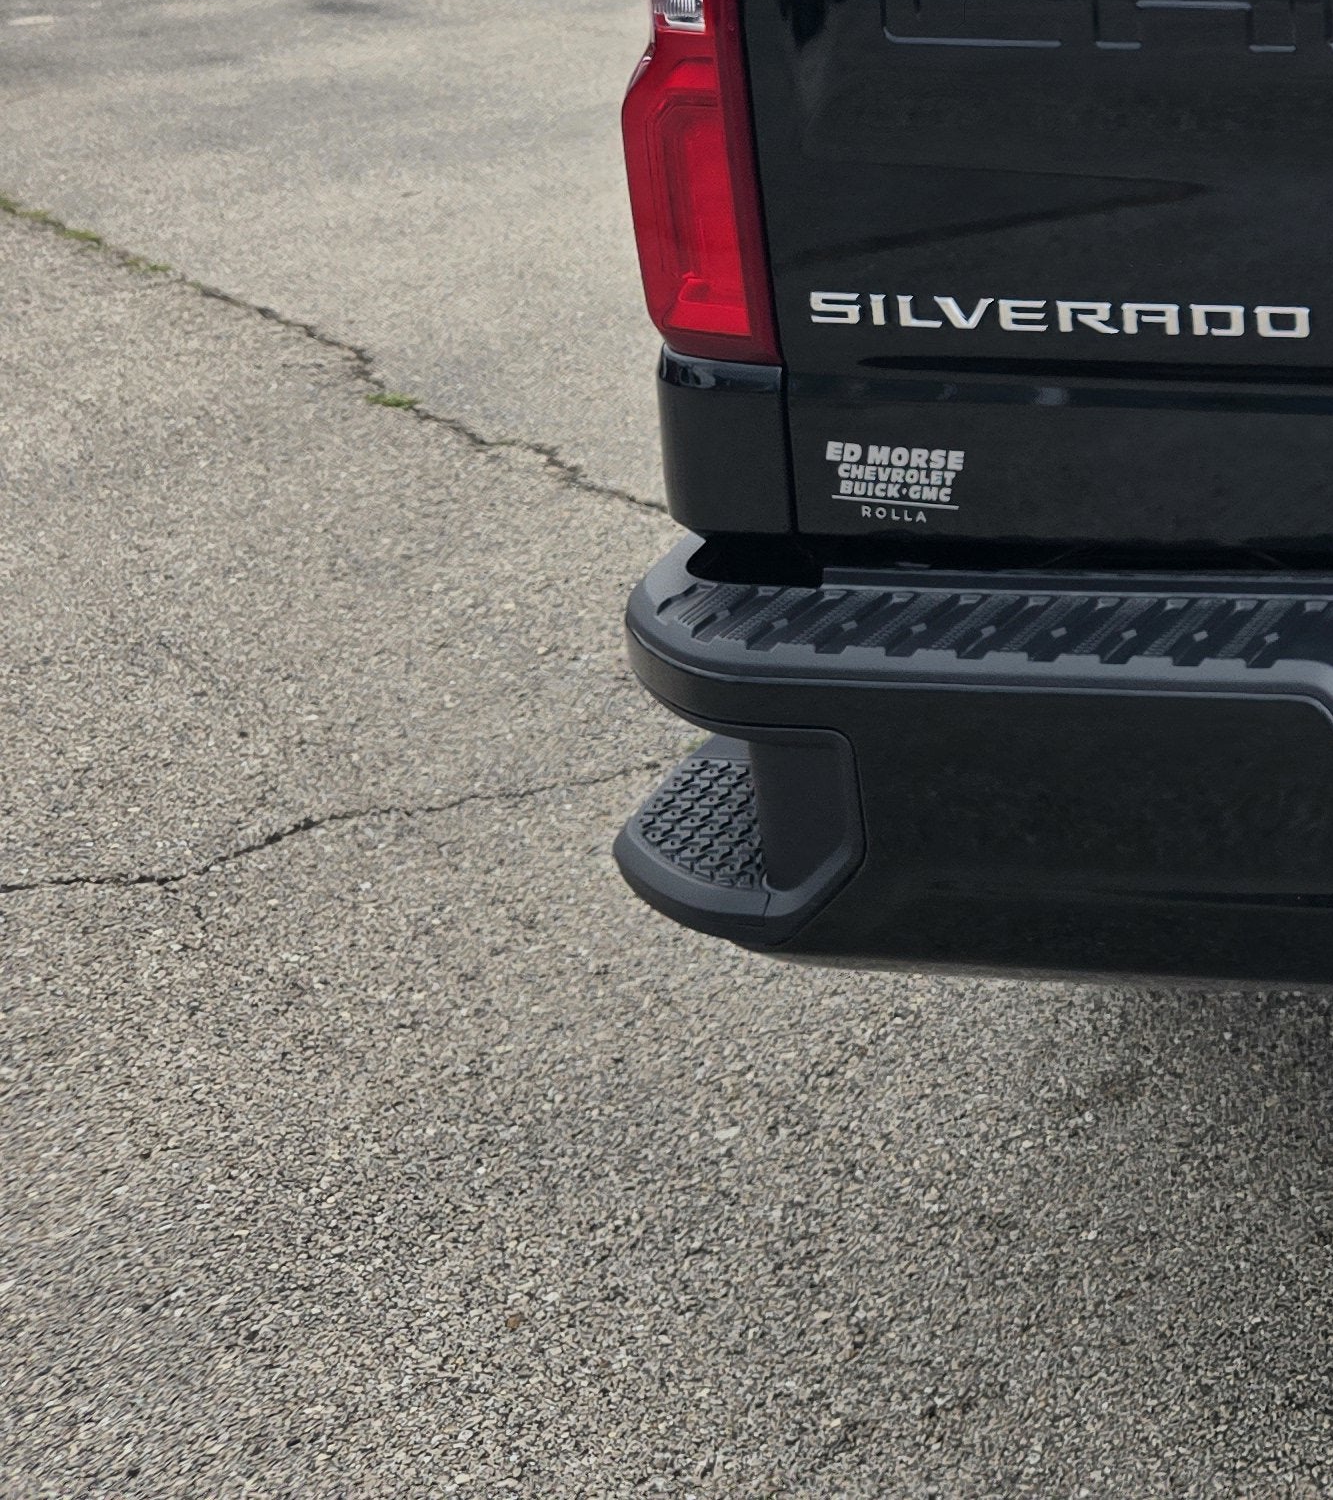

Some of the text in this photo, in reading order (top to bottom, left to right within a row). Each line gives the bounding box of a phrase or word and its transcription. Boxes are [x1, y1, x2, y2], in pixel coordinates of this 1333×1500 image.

[809, 291, 1311, 338] SILVERADO
[825, 440, 965, 471] ED MORSE
[837, 462, 957, 487] CHEVROLET
[860, 505, 927, 523] ROLLA
